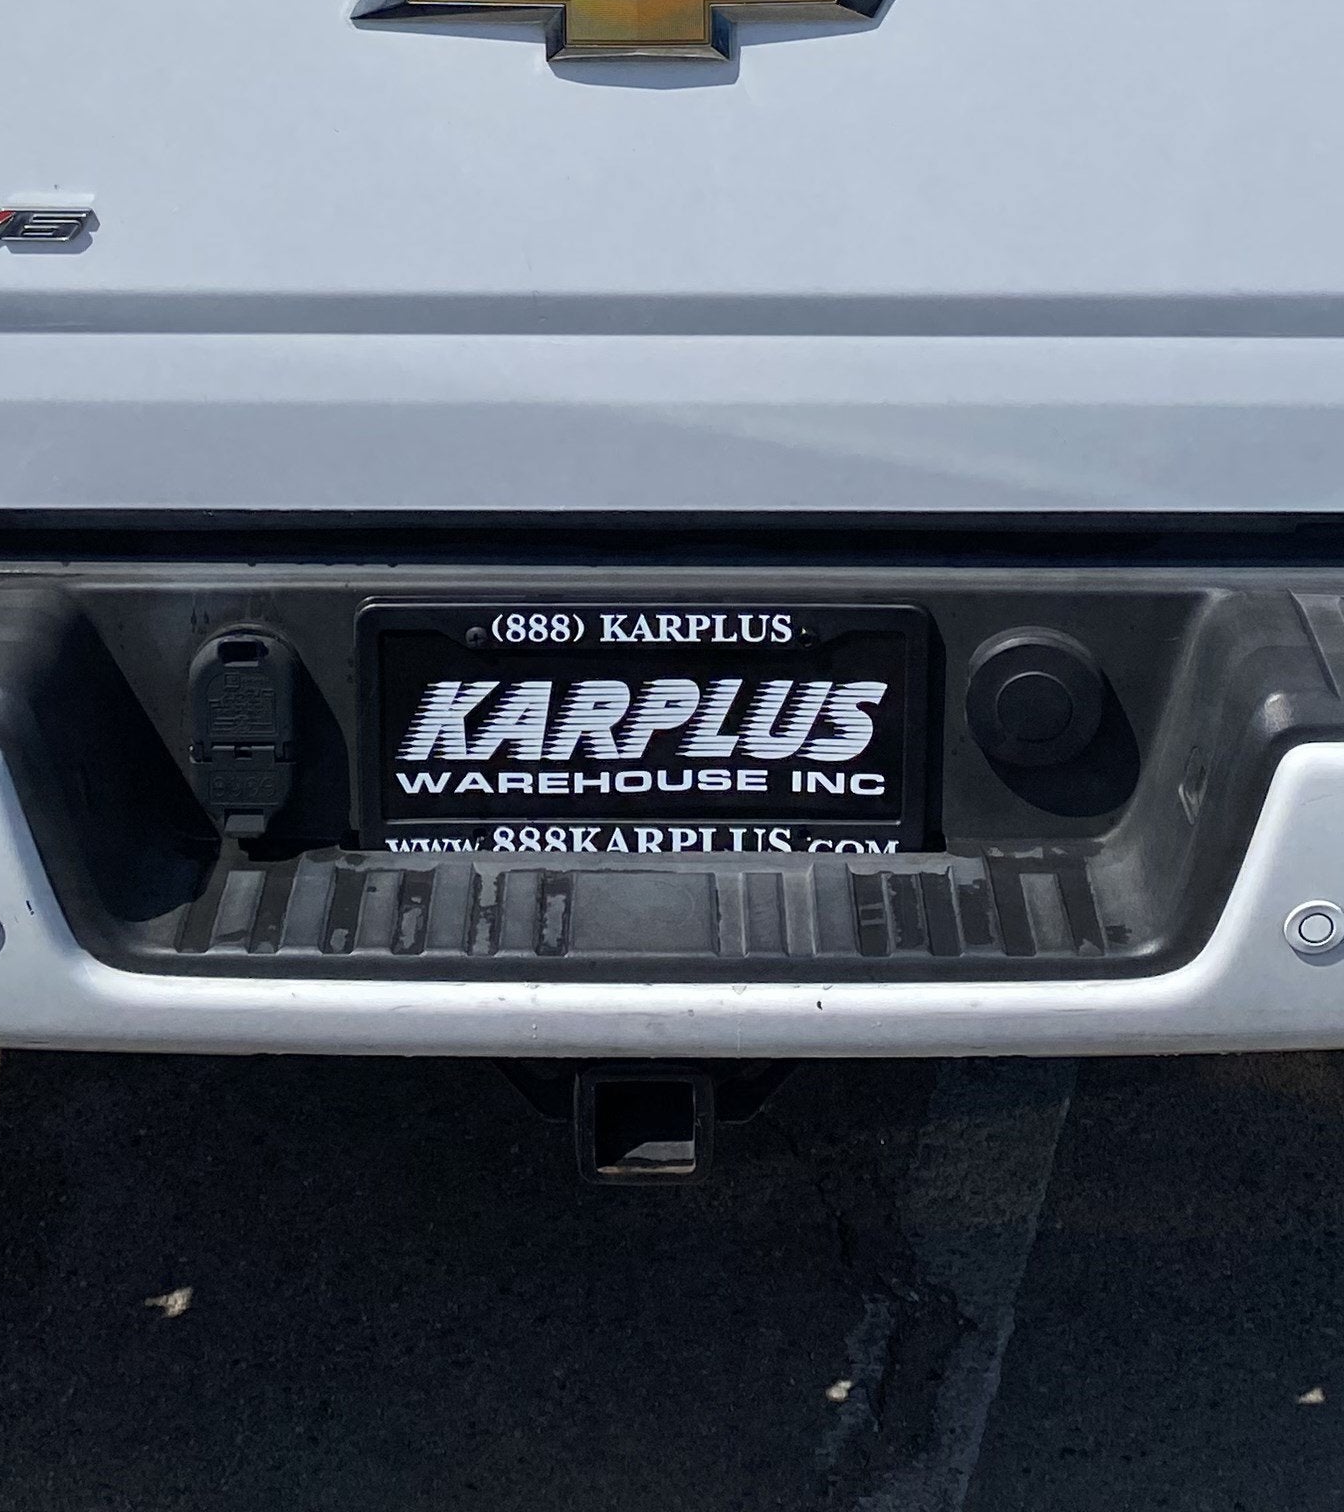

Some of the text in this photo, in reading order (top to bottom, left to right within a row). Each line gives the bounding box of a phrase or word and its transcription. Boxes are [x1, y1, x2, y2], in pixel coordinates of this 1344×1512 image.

[491, 613, 793, 644] (888) KARPLUS
[395, 678, 888, 762] KARPLUS
[396, 769, 886, 796] WAREHOUSE INC
